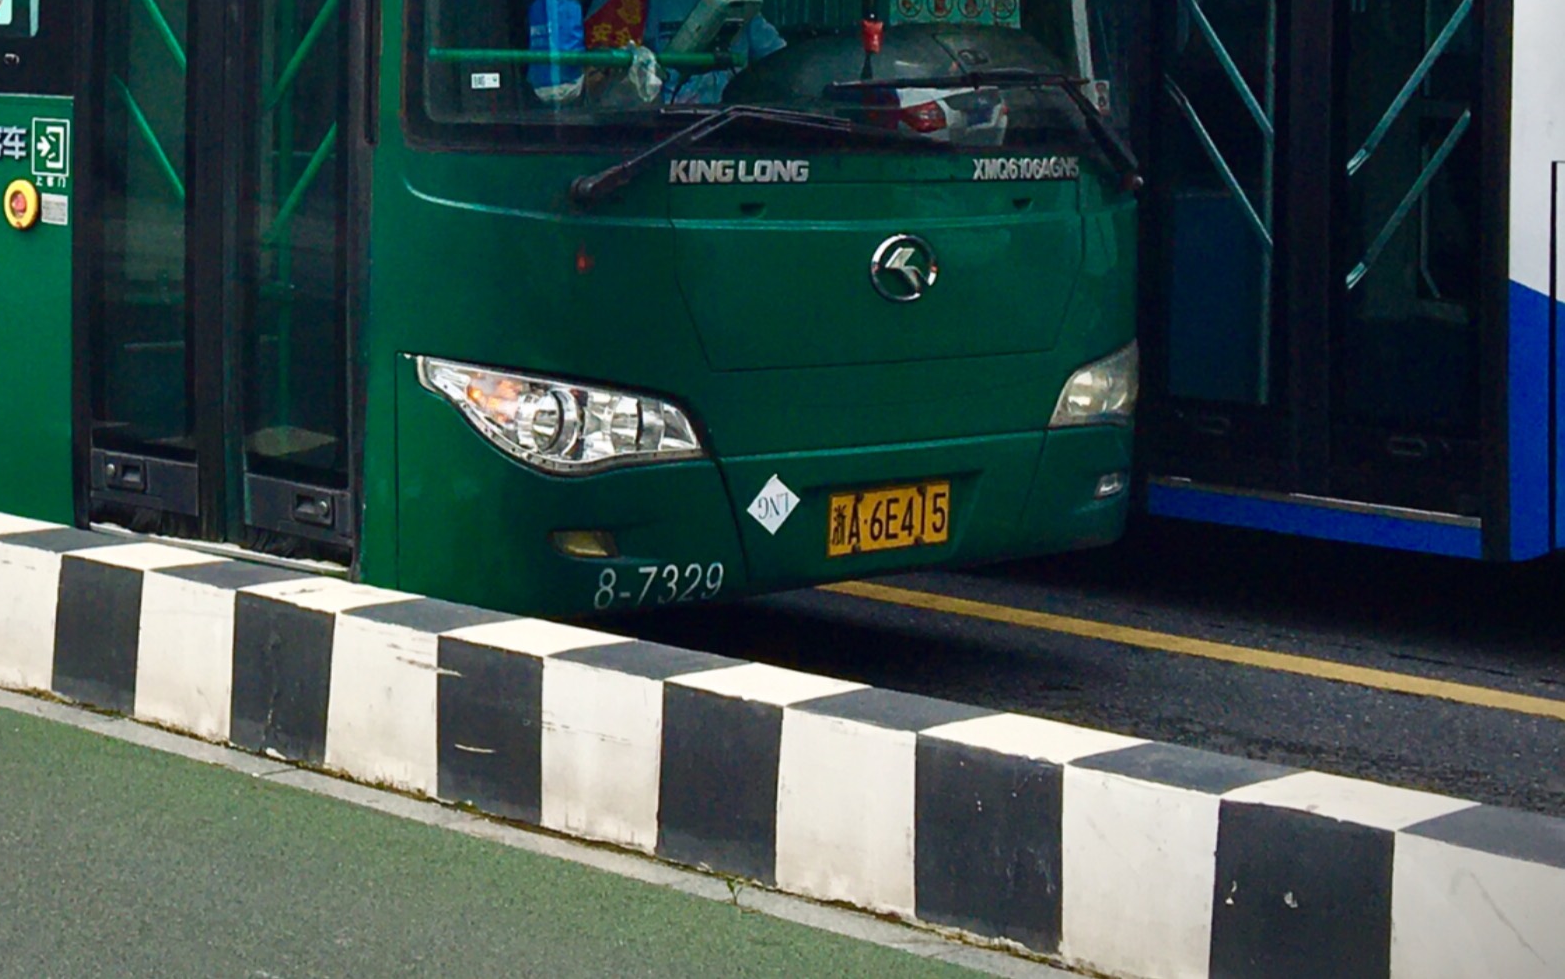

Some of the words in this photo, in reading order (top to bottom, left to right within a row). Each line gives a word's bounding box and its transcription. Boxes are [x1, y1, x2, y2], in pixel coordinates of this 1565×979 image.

[669, 160, 735, 183] KING
[738, 160, 810, 183] LONG
[593, 561, 725, 610] 8-7329
